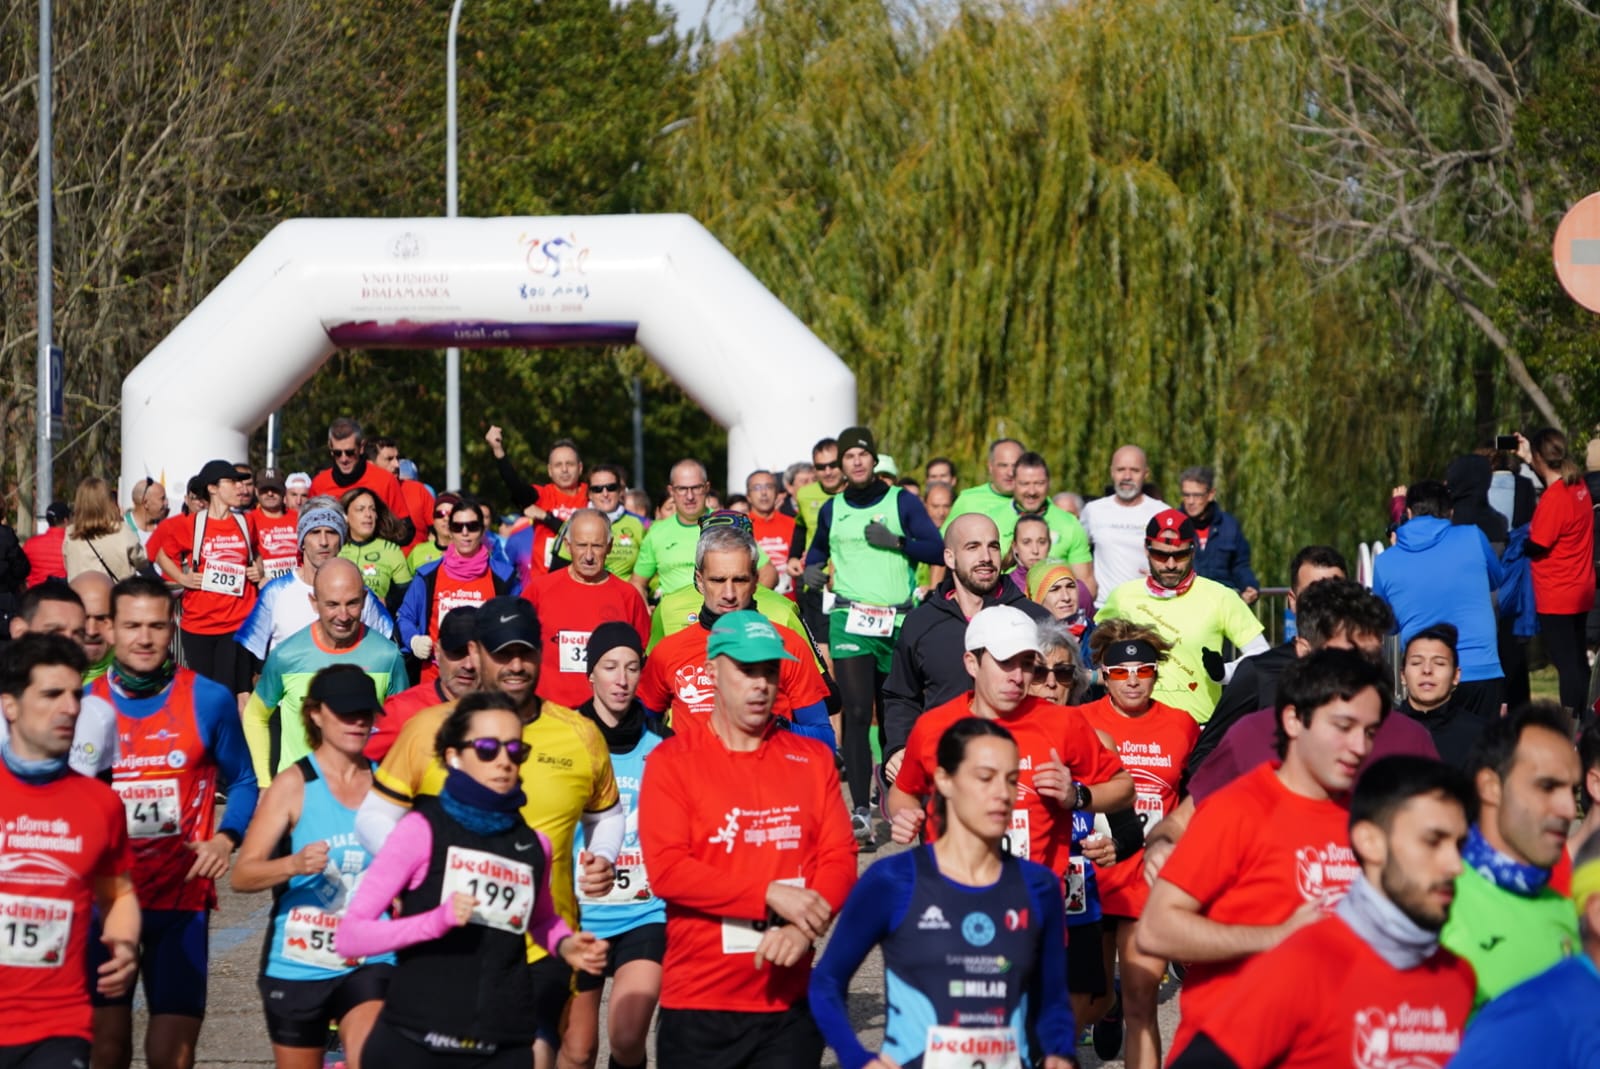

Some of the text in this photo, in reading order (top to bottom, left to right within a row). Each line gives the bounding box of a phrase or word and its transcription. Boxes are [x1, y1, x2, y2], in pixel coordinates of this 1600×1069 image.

[454, 327, 511, 339] usal.es
[206, 562, 245, 575] bedunia
[211, 572, 237, 587] 203
[858, 615, 883, 629] 291
[133, 802, 160, 822] 41
[450, 853, 531, 886] bedunia
[468, 878, 516, 911] 199
[5, 922, 39, 948] 15
[965, 980, 1007, 998] MILAR
